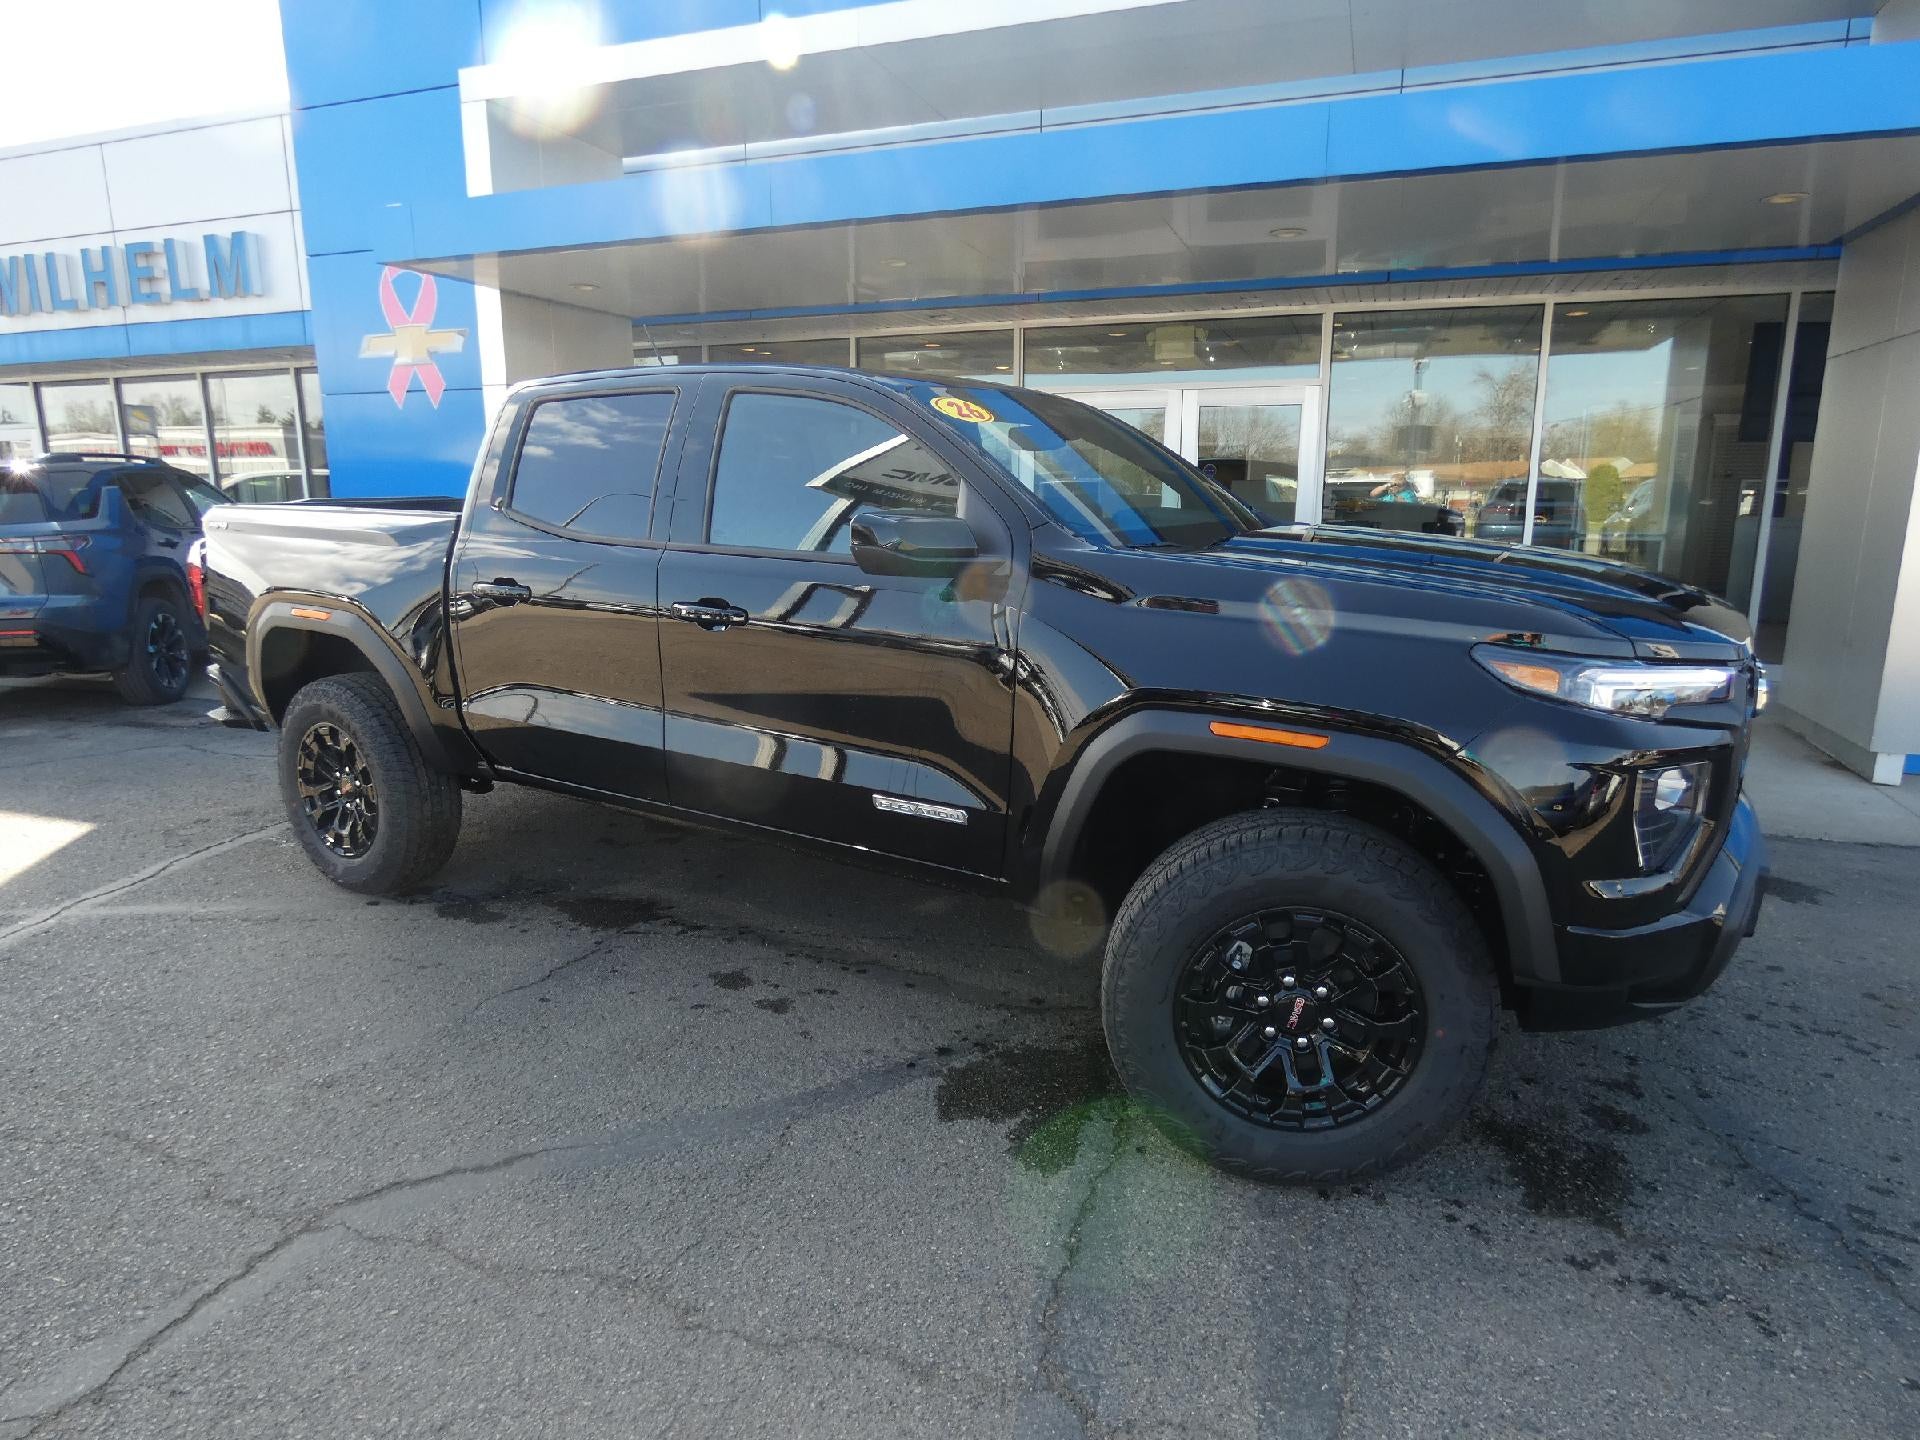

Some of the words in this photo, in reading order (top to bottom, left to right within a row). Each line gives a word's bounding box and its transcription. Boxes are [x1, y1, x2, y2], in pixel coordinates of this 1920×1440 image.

[946, 401, 986, 419] 26
[876, 800, 964, 822] ELEVATION
[1287, 997, 1305, 1030] GMC
